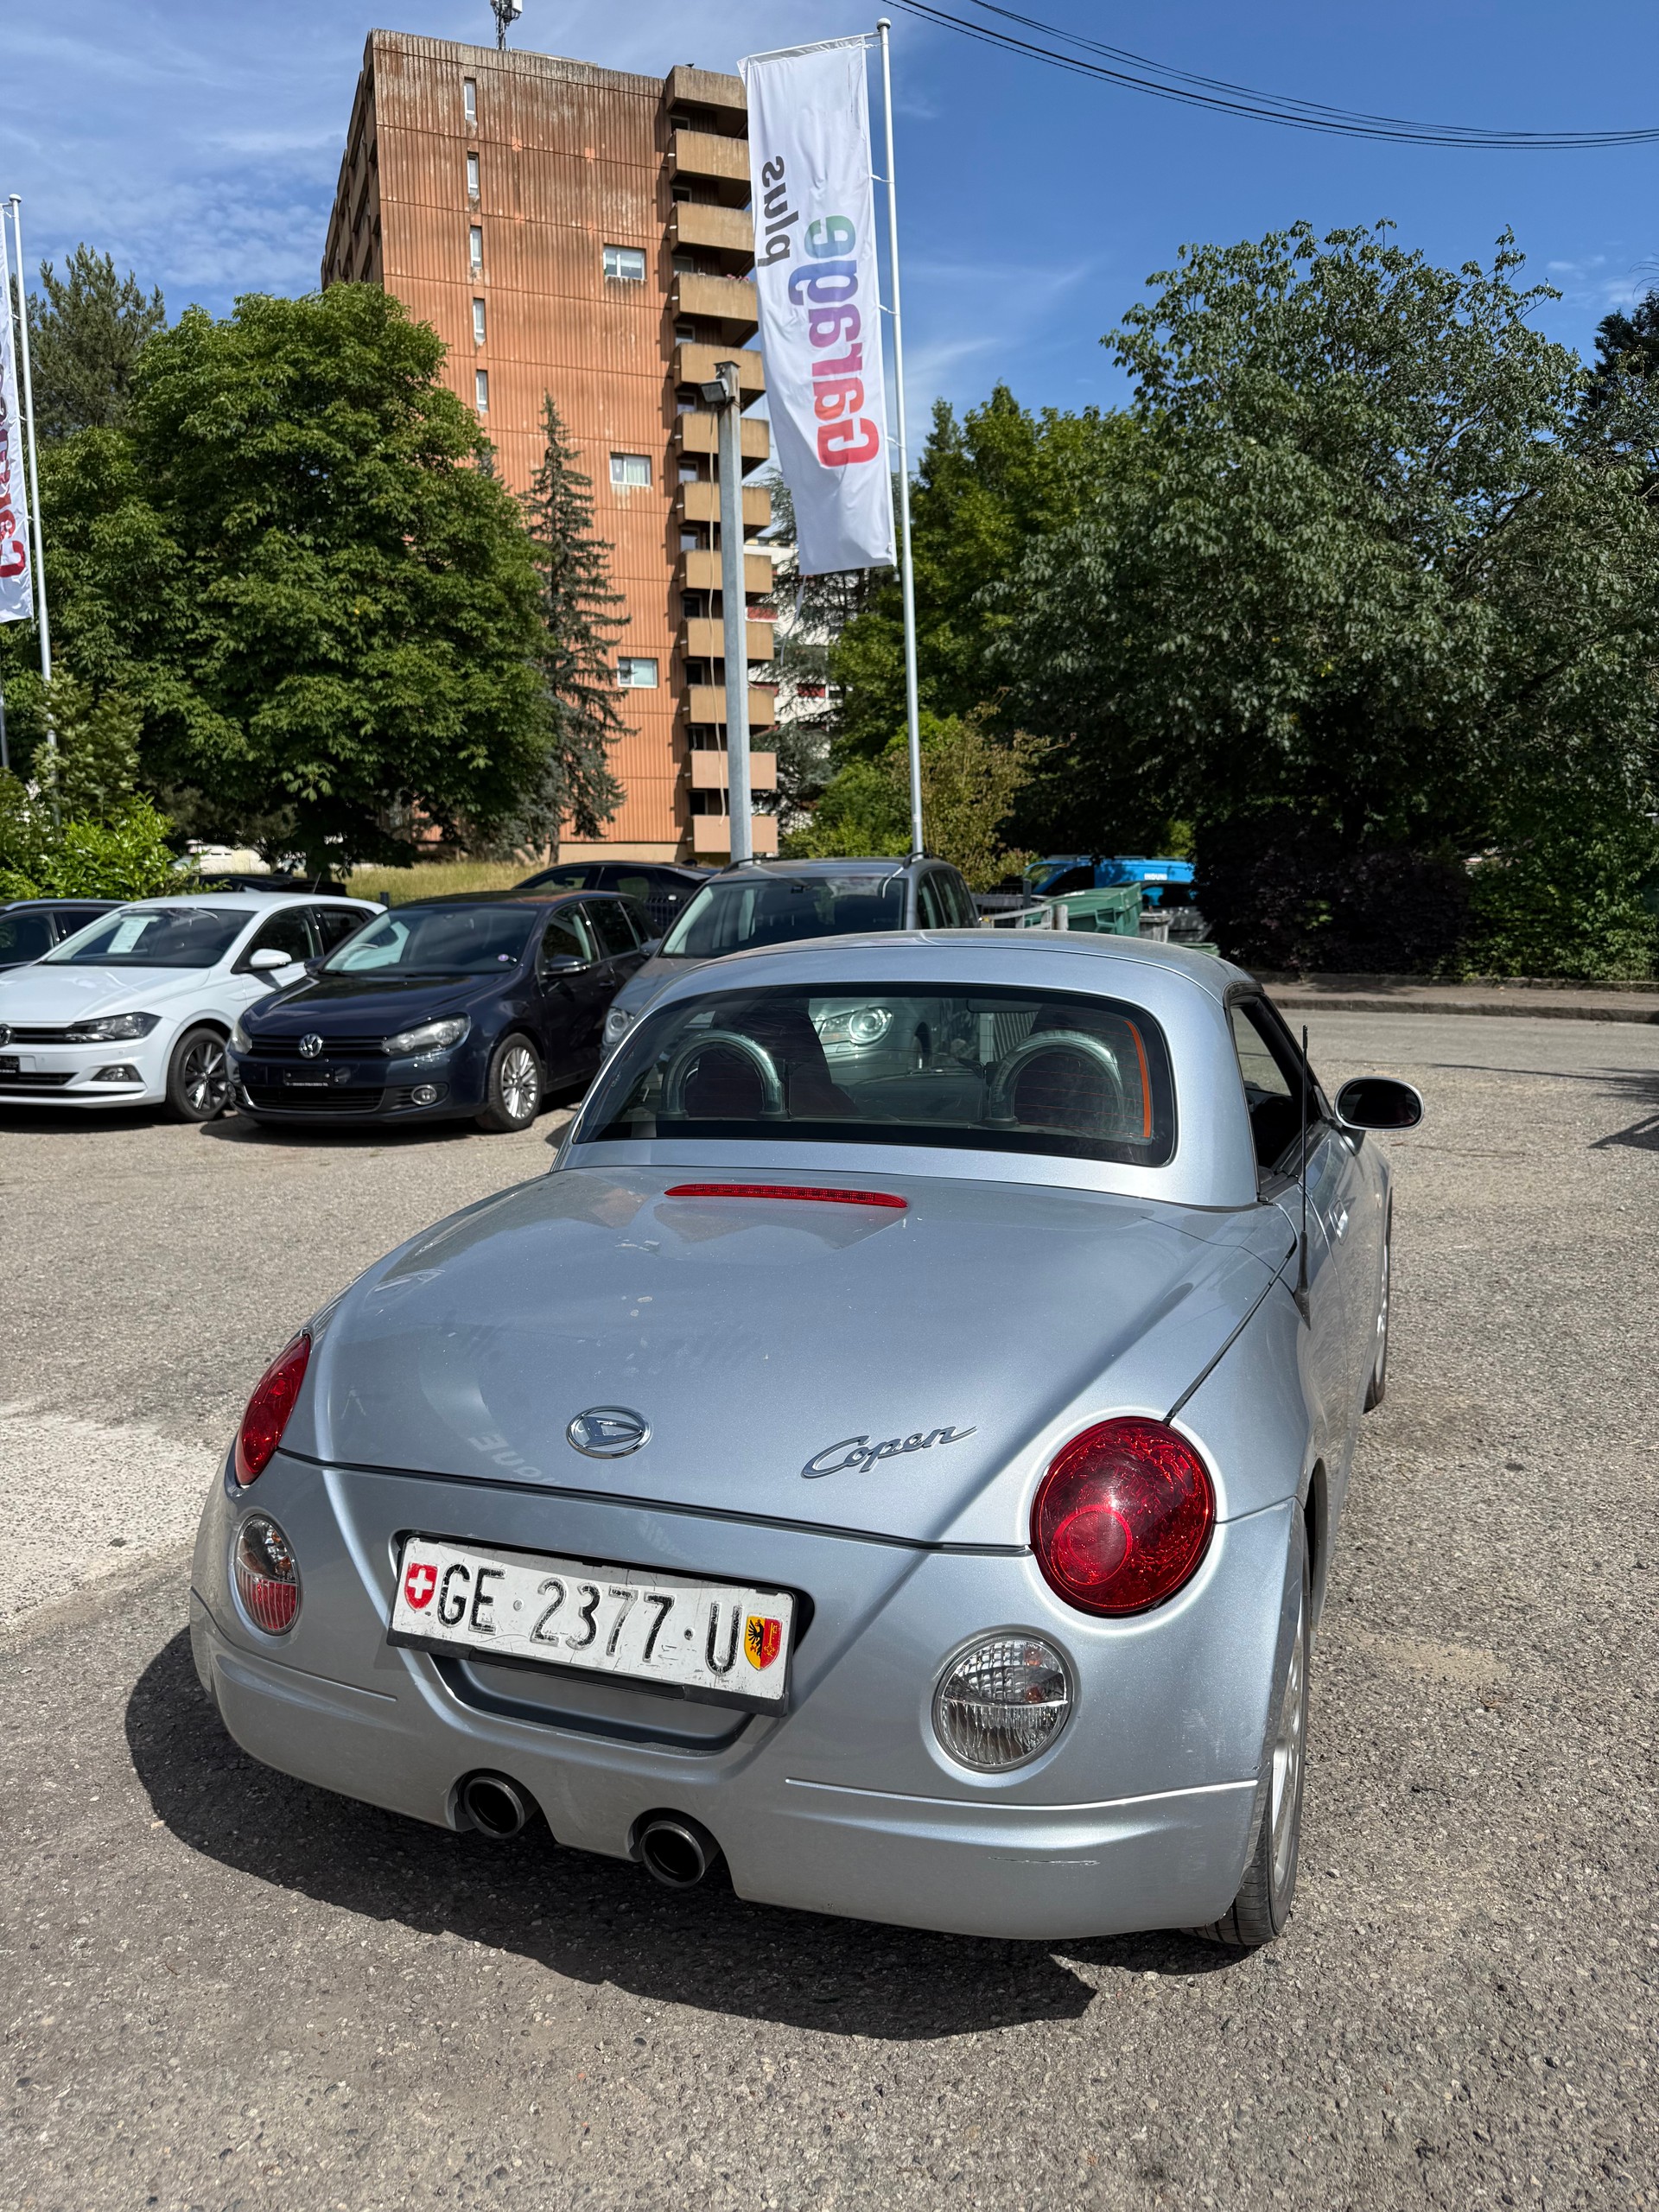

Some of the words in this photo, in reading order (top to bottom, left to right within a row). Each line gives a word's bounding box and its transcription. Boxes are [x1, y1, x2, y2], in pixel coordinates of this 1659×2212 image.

[801, 1425, 978, 1478] Copen
[437, 1563, 506, 1635] GE
[530, 1578, 676, 1663] 2377
[703, 1601, 744, 1677] U
